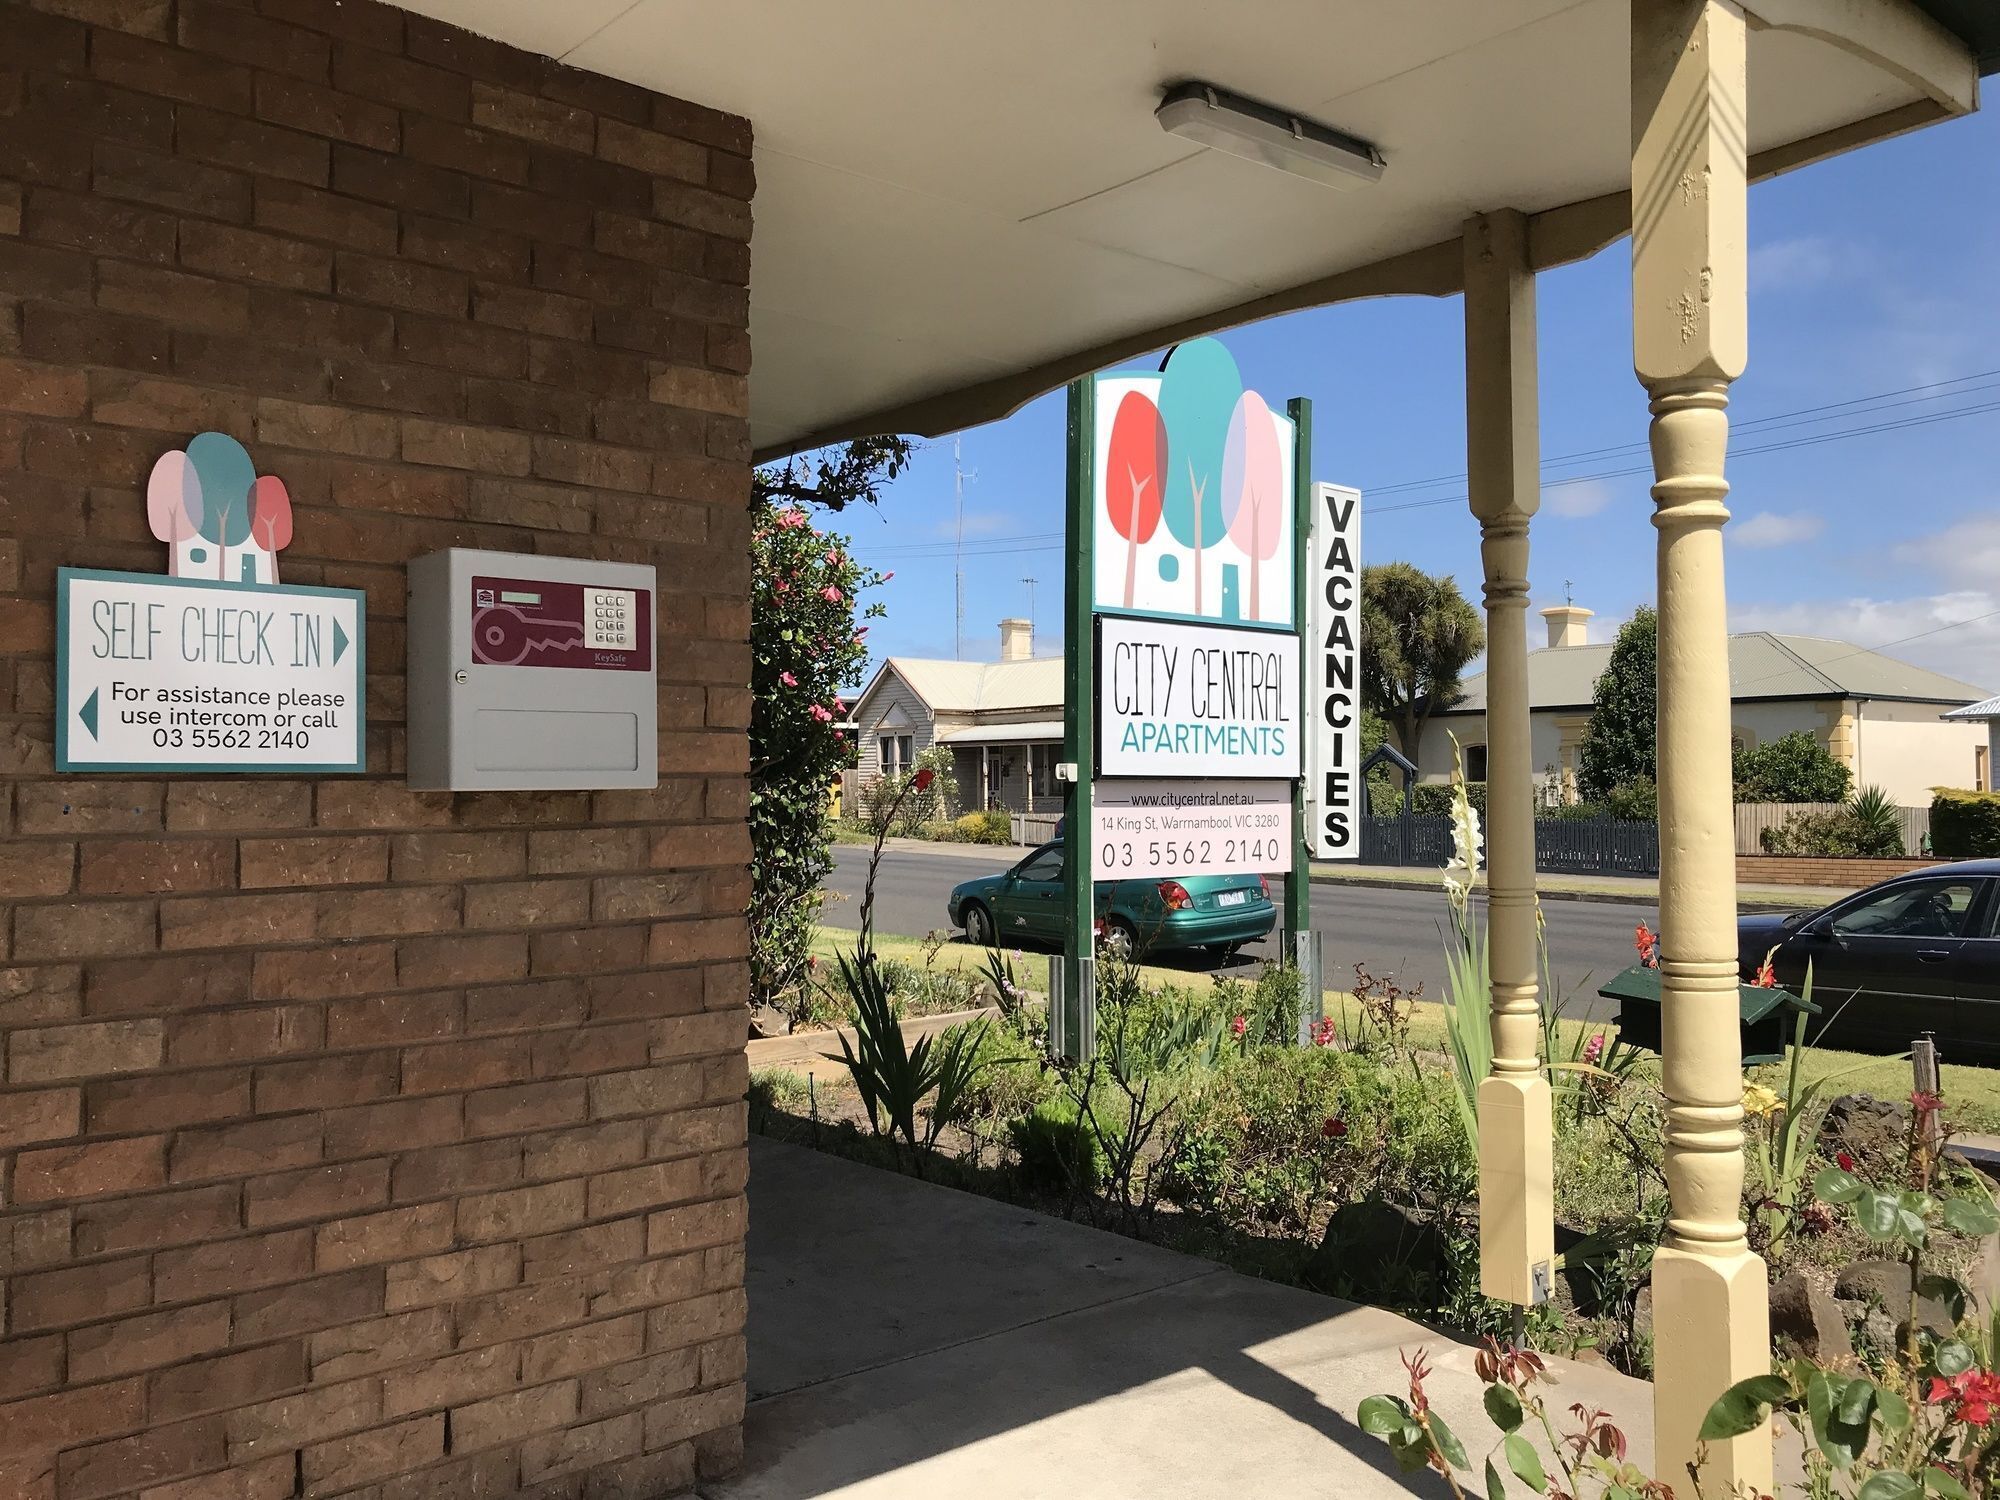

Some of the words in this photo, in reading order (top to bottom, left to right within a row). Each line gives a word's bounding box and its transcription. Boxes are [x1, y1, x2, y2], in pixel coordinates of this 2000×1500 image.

[92, 600, 165, 660] SELF
[182, 606, 274, 666] CHECK
[290, 612, 321, 668] IN
[595, 653, 626, 663] KeySafe
[1324, 496, 1355, 848] VACANCIES
[1114, 642, 1178, 717] CITY
[1191, 648, 1289, 721] CENTRAL
[112, 682, 150, 701] For
[157, 685, 270, 705] assistance
[278, 688, 345, 710] please
[121, 710, 161, 725] use
[170, 708, 267, 727] intercom
[274, 713, 296, 728] or
[302, 710, 338, 728] call
[153, 728, 183, 748] 03
[192, 729, 251, 749] 5562
[258, 730, 309, 749] 2140
[1121, 722, 1285, 756] APARTMENTS
[1131, 792, 1254, 810] www.citycentral.net.au
[1102, 817, 1114, 831] 14
[1117, 816, 1141, 834] King
[1145, 816, 1158, 832] St,
[1161, 815, 1232, 830] Warrnambool
[1235, 815, 1252, 828] VIC
[1255, 814, 1280, 828] 3280
[1102, 842, 1133, 868] 03
[1149, 840, 1211, 866] 5562
[1225, 838, 1279, 863] 2140
